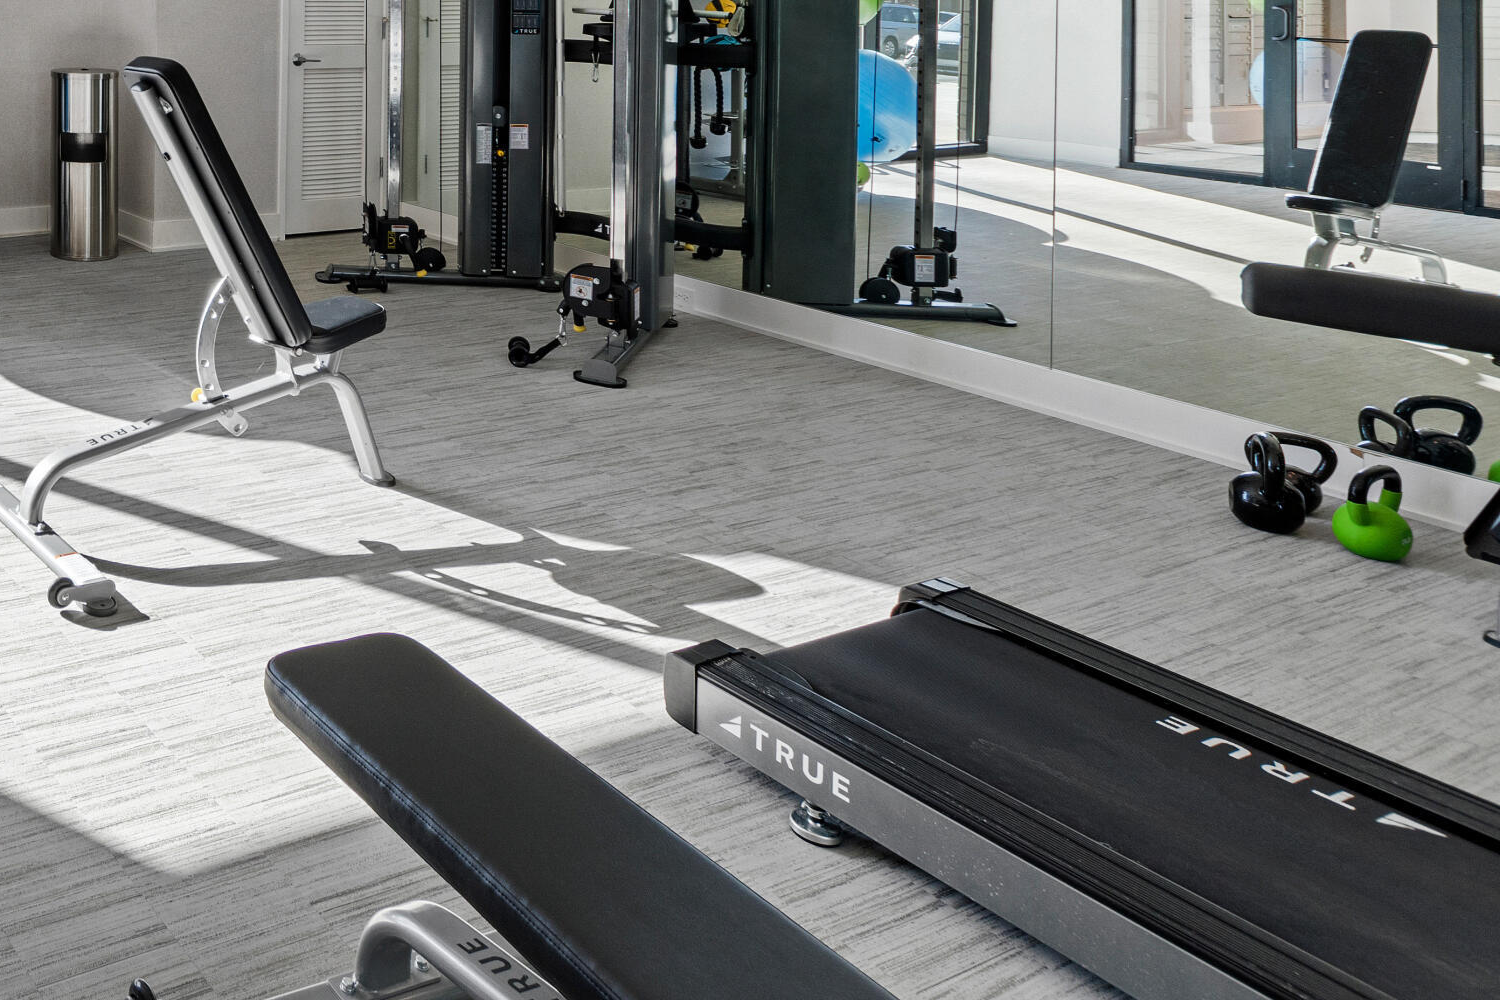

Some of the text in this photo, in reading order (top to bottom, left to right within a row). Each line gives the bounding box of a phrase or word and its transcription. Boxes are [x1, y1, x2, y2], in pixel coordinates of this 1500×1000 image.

[86, 424, 142, 446] TRUE
[750, 722, 851, 804] TRUE
[1156, 715, 1357, 811] TRUE
[456, 937, 562, 1000] RUE
